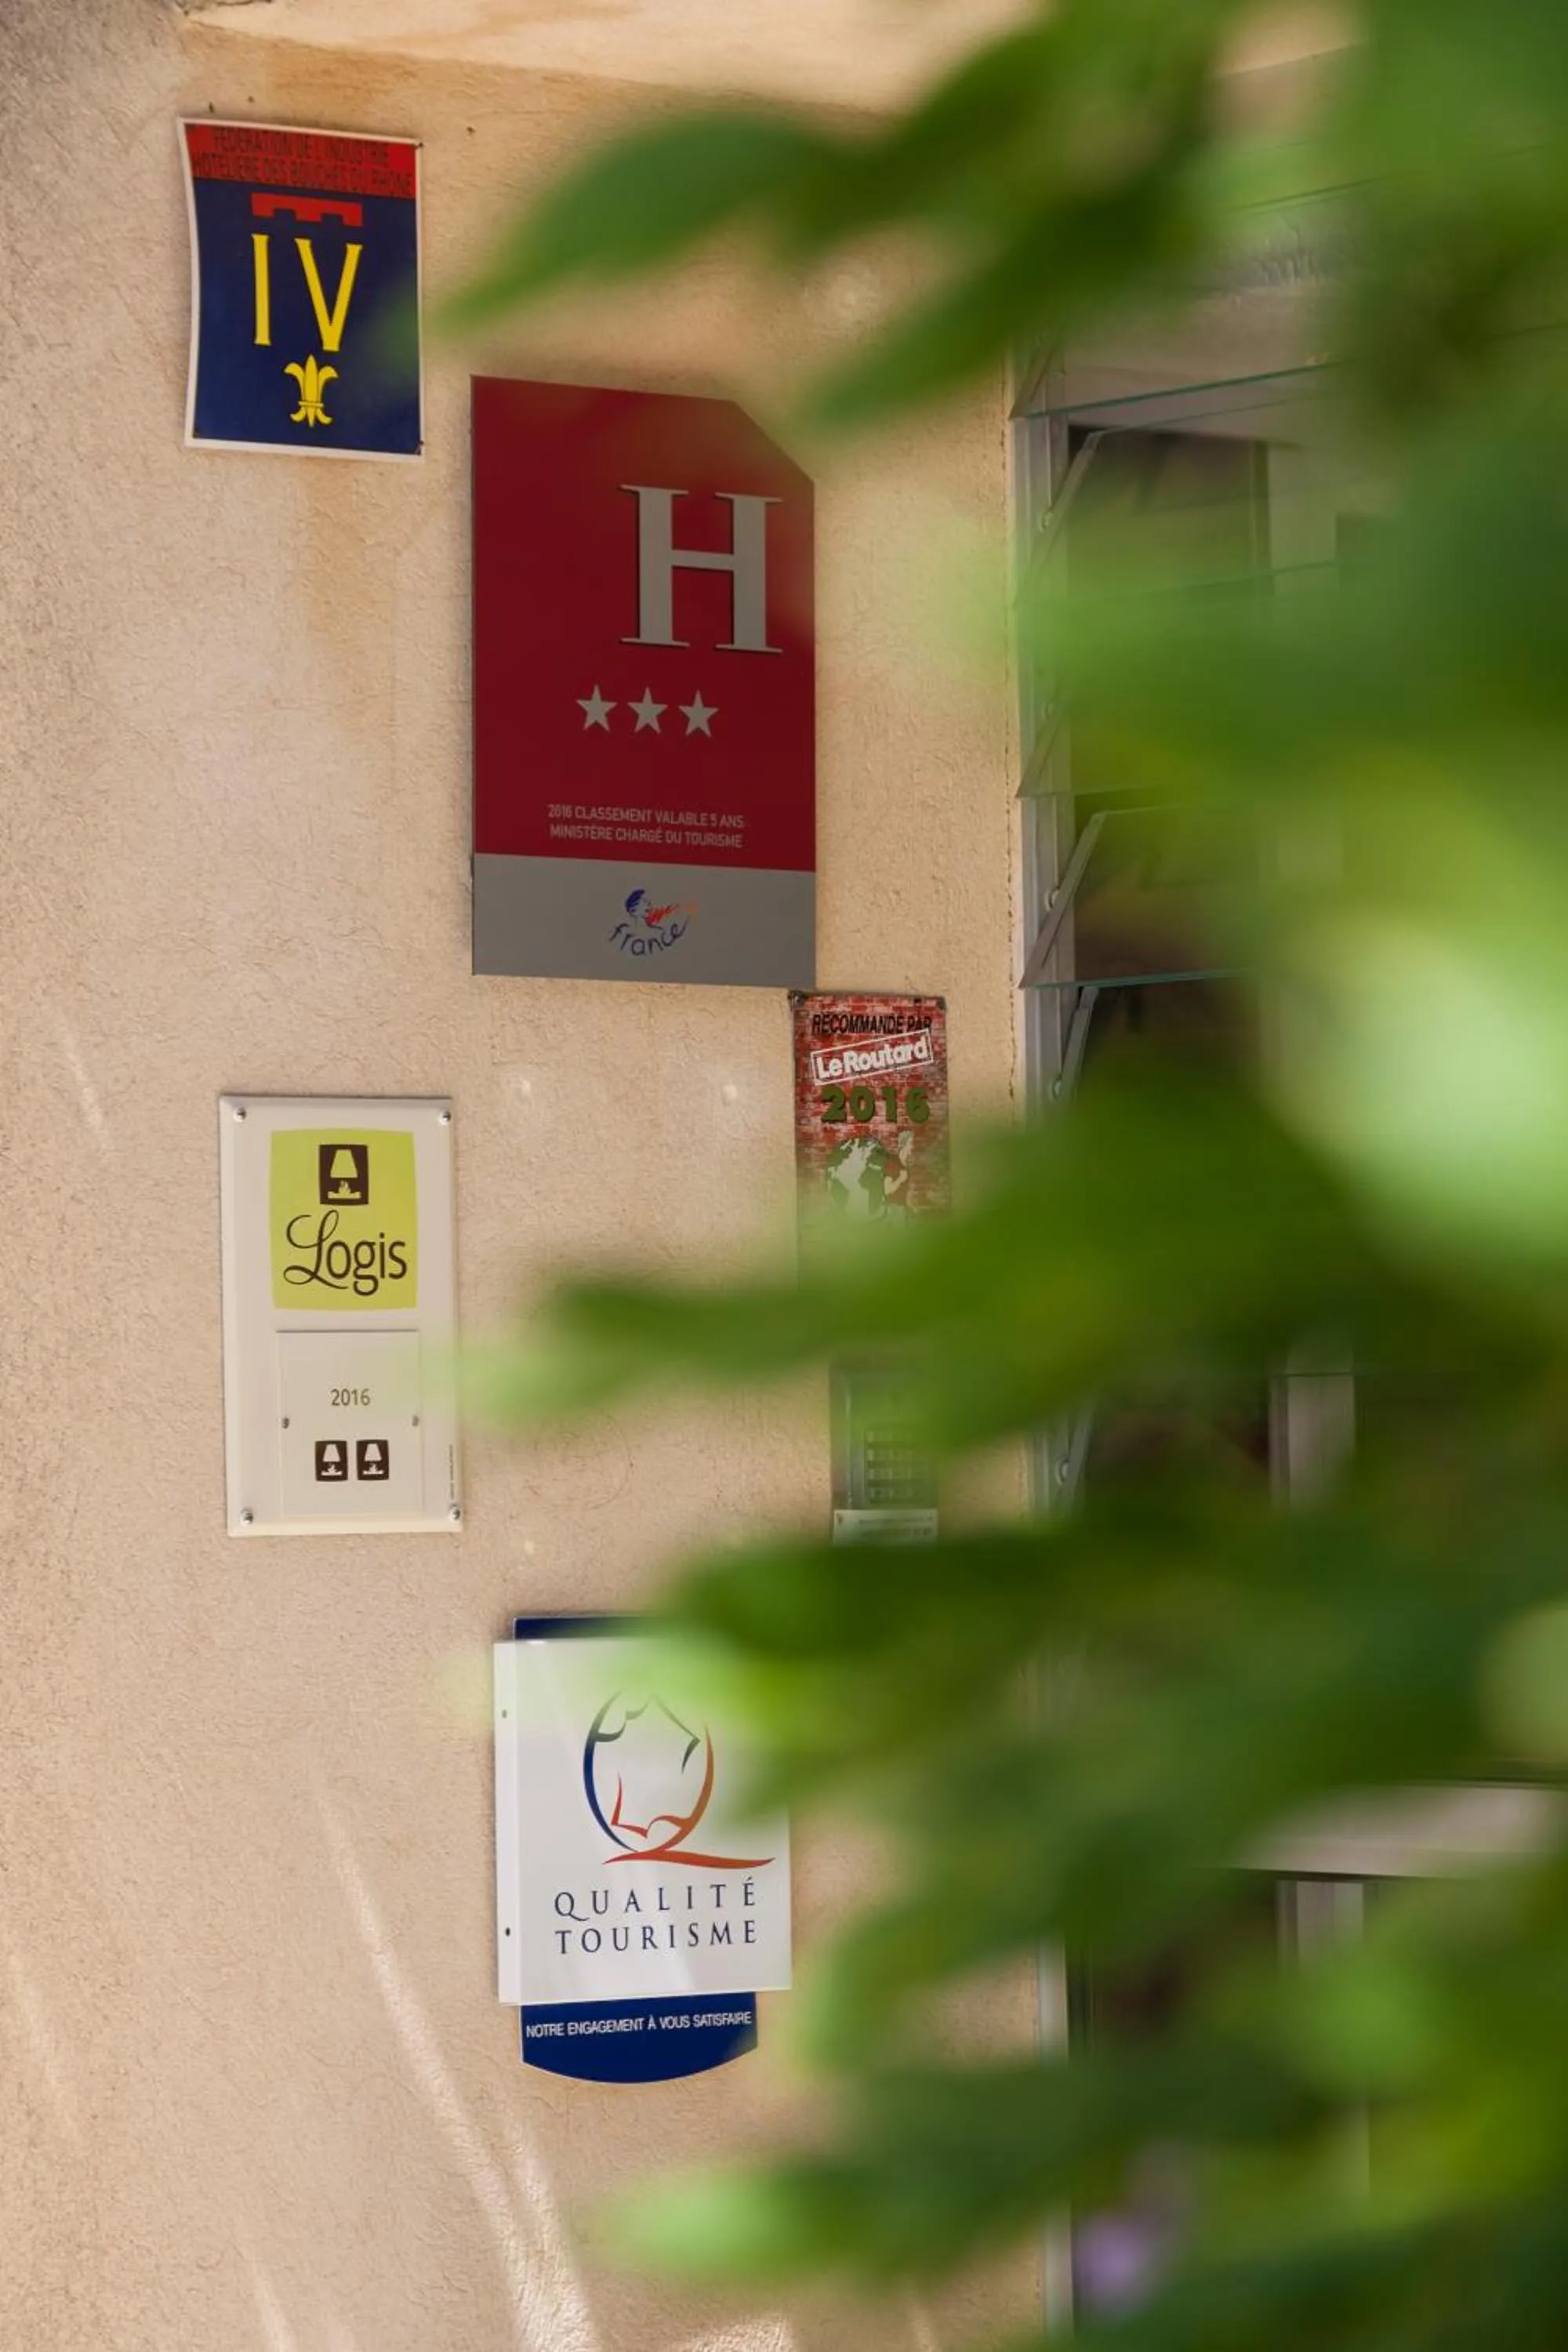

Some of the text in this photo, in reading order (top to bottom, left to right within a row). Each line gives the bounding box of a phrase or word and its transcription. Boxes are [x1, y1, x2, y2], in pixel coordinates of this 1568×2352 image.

[619, 484, 782, 653] H
[548, 804, 744, 828] 2016 CLASSEMENT VALABLE 5 ANS
[550, 823, 743, 848] MINISTÈRE CHARGÉ DU TOURISME
[907, 1015, 931, 1033] PAR
[843, 1036, 929, 1073] Routard
[821, 1086, 931, 1123] 2016
[284, 1210, 407, 1296] Logis
[330, 1388, 371, 1406] 2016
[554, 1877, 755, 1922] QUALITÉ
[555, 1919, 757, 1955] TOURISME
[526, 2011, 752, 2038] NOTRE ENGAGEMENT À VOUS SATISFAIRE
